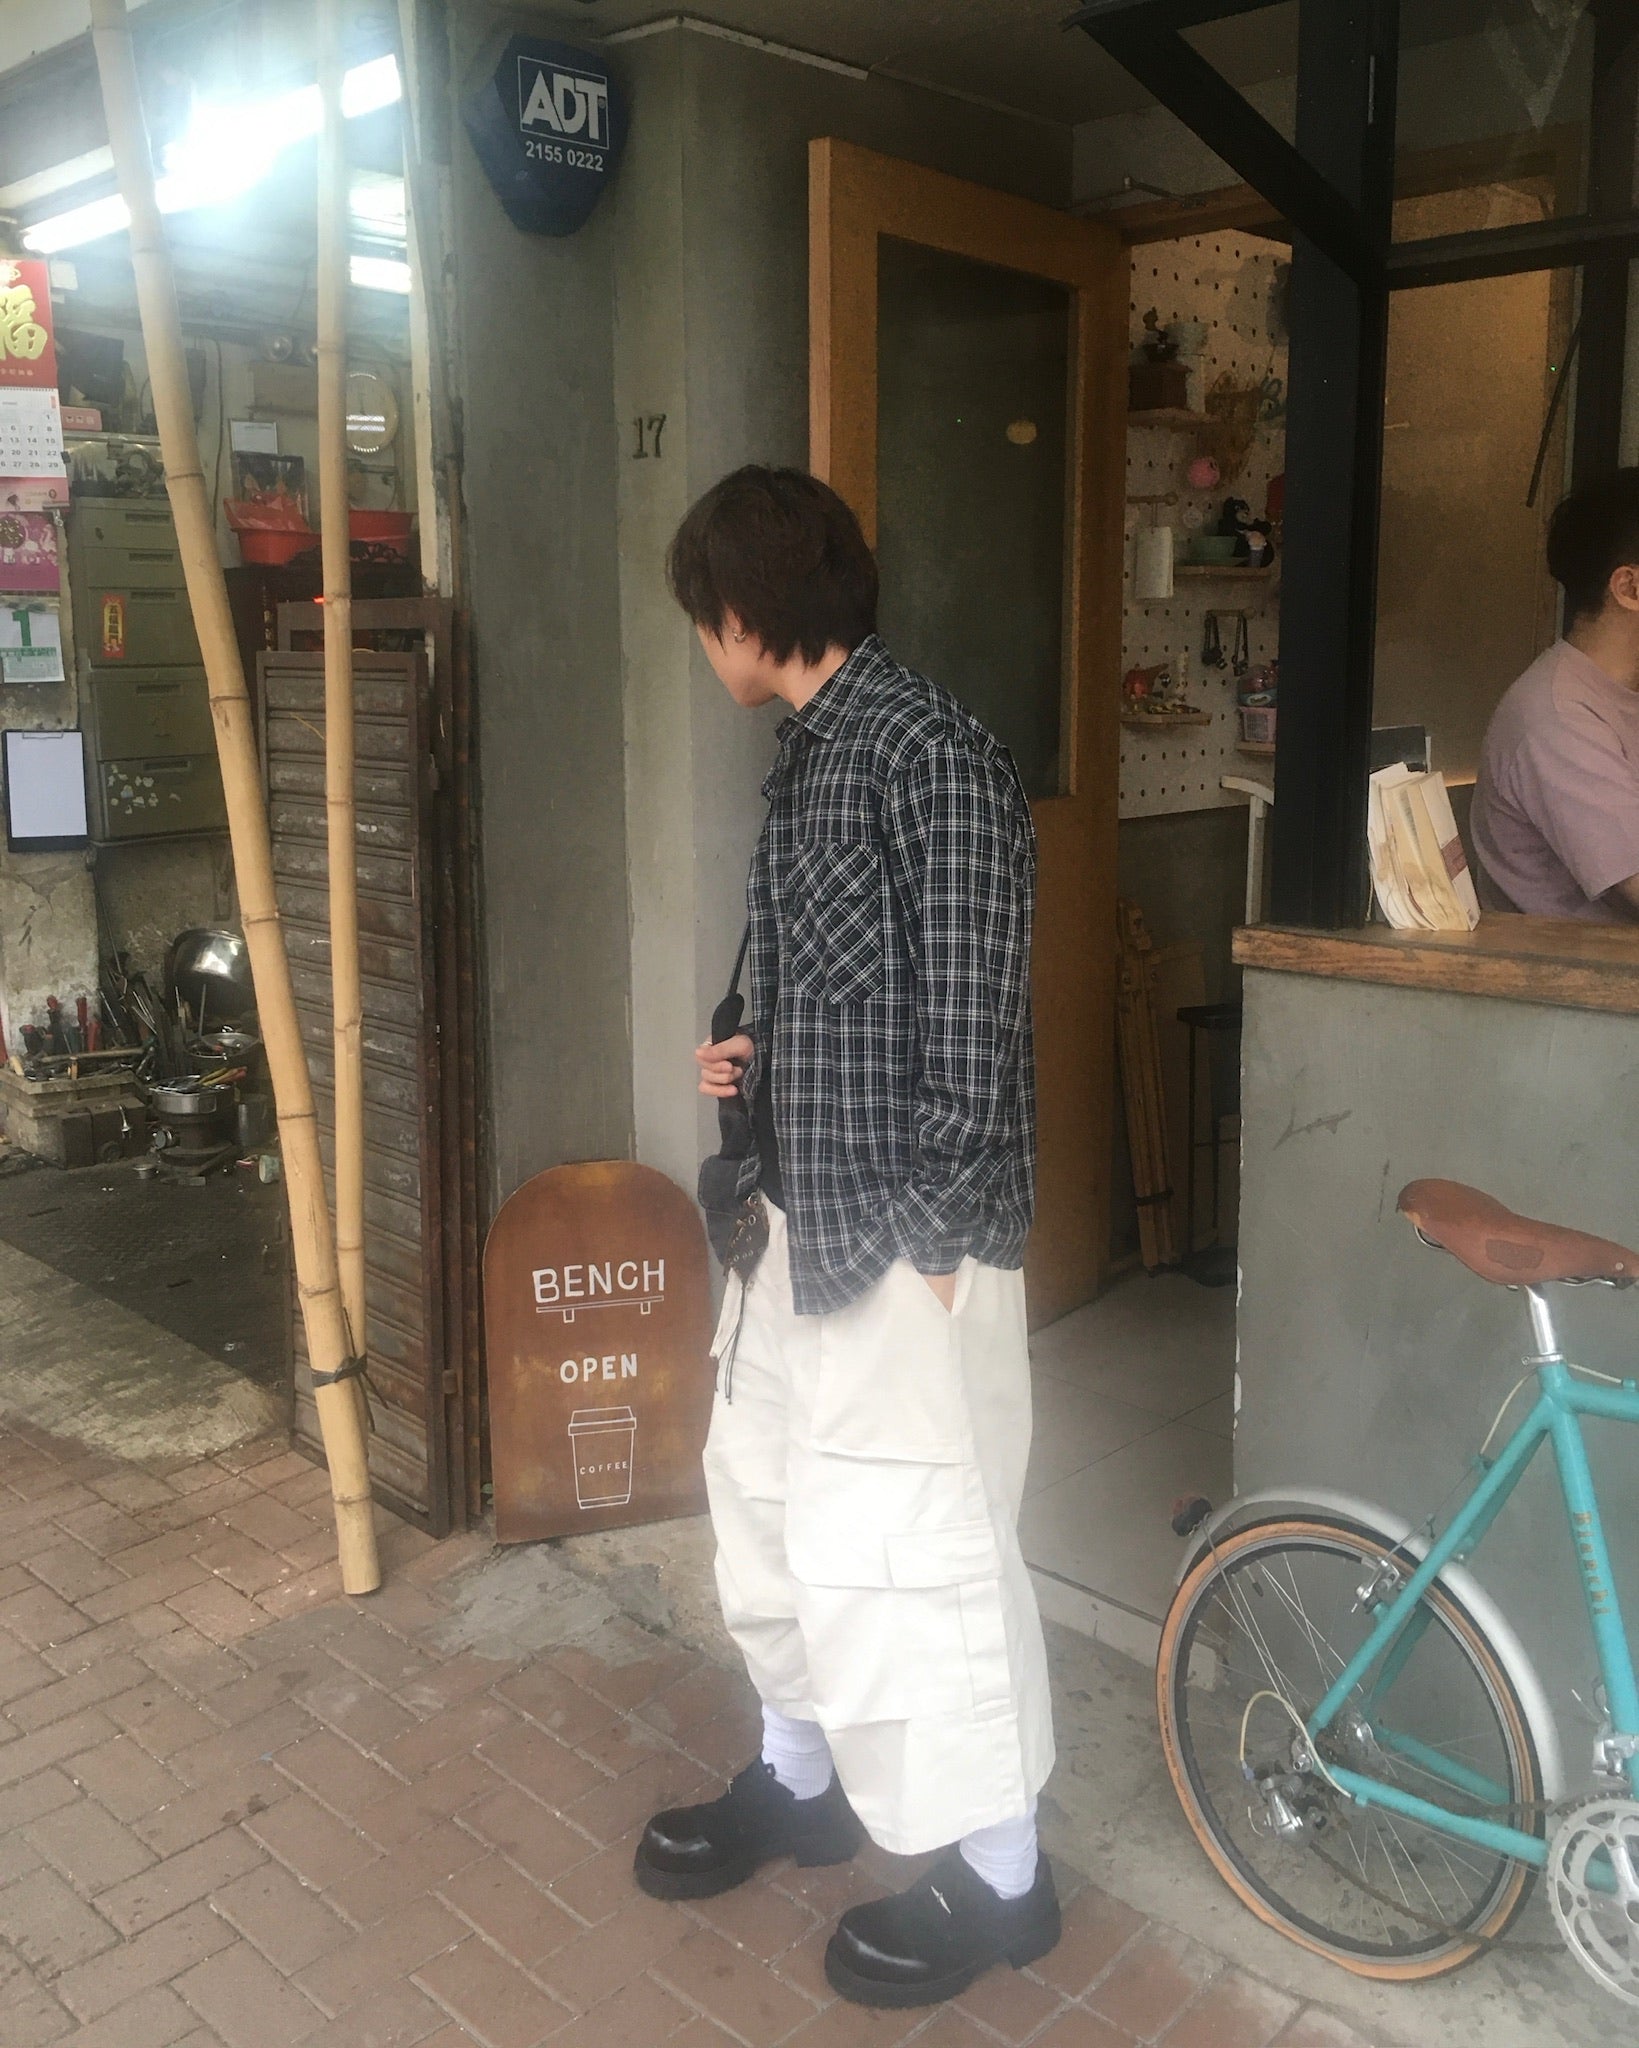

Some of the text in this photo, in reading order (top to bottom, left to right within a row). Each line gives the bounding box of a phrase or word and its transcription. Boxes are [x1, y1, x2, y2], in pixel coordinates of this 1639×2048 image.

[521, 69, 608, 141] ADT
[525, 140, 604, 172] 2155 0222
[632, 413, 667, 460] 17
[532, 1258, 665, 1304] BENCH
[559, 1352, 638, 1384] OPEN
[579, 1460, 628, 1475] COFFEE
[1573, 1510, 1611, 1616] Bianchi
